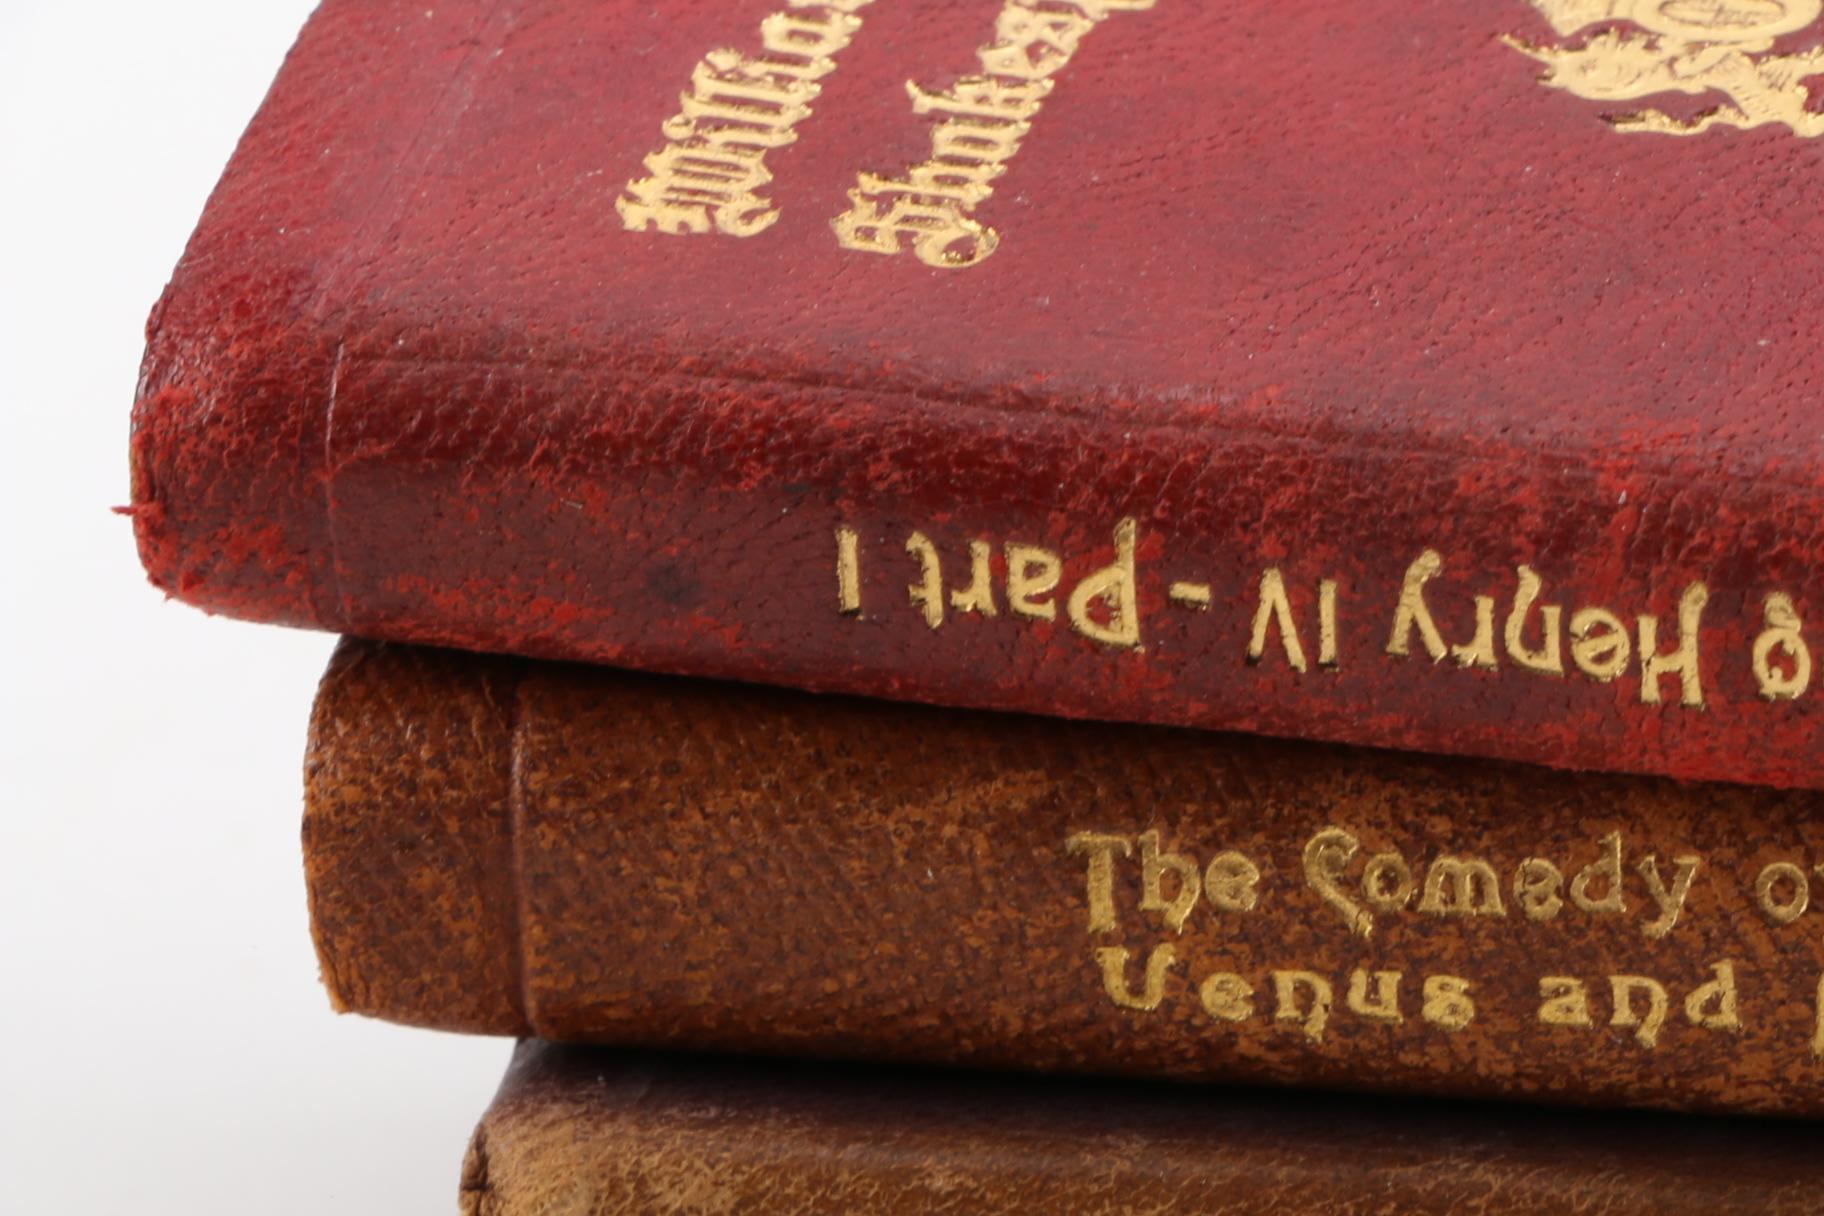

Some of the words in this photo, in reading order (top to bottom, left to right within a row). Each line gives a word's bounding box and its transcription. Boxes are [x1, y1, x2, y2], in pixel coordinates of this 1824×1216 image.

[615, 0, 875, 237] Willia
[905, 518, 1145, 654] Part
[1245, 566, 1338, 672] IV
[1387, 549, 1709, 708] Henry
[1065, 829, 1262, 935] The
[1298, 825, 1703, 942] Comedy
[1094, 940, 1477, 1043] Venus
[1535, 955, 1742, 1050] and
